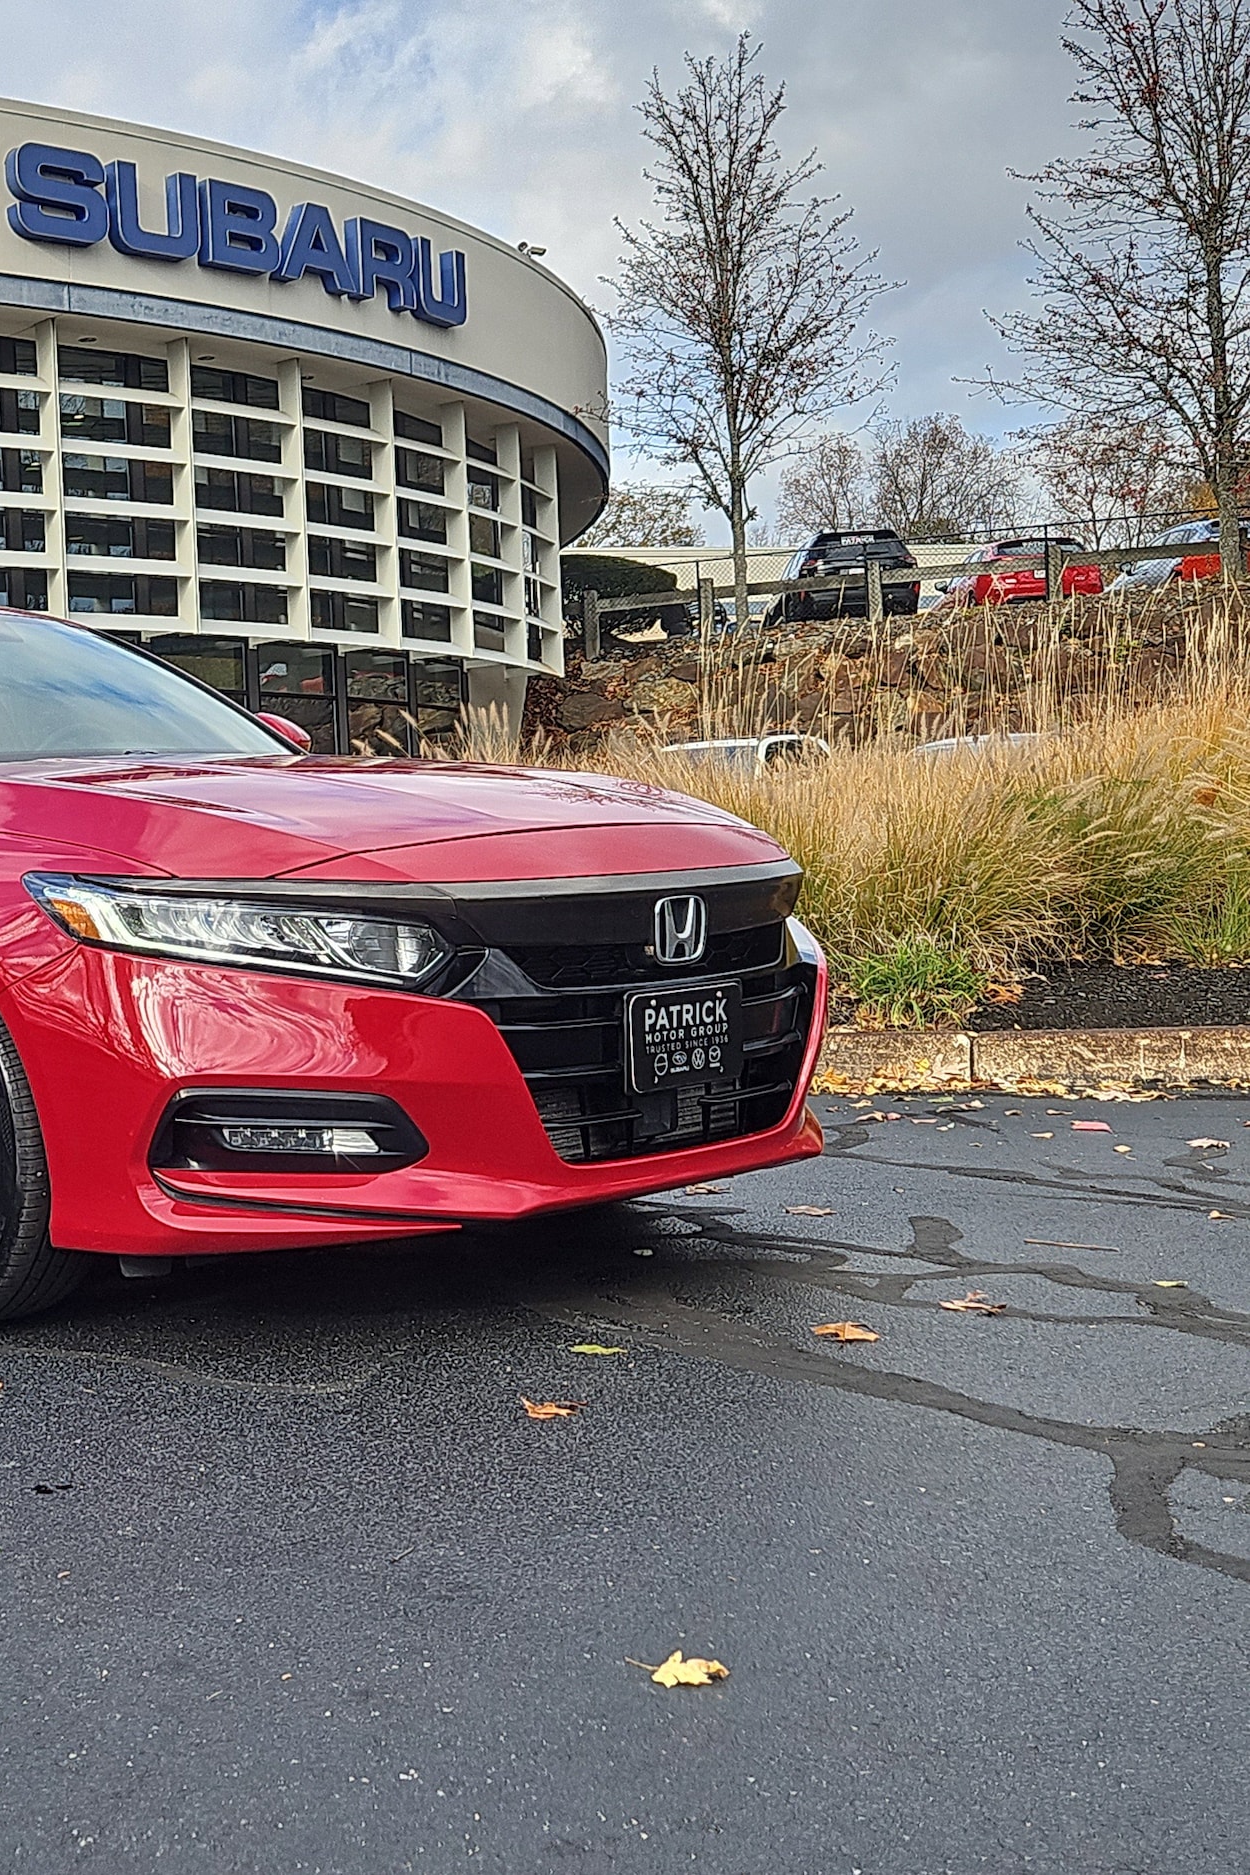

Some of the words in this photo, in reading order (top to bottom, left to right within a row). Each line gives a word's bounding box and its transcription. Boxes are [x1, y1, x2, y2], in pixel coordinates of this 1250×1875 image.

[5, 142, 469, 329] SUBARU
[645, 999, 728, 1032] PATRICK
[645, 1028, 685, 1044] MOTOR
[691, 1022, 728, 1037] GROUP
[646, 1041, 682, 1054] TRUSTED
[685, 1037, 708, 1049] SINCE
[712, 1034, 729, 1044] 1936
